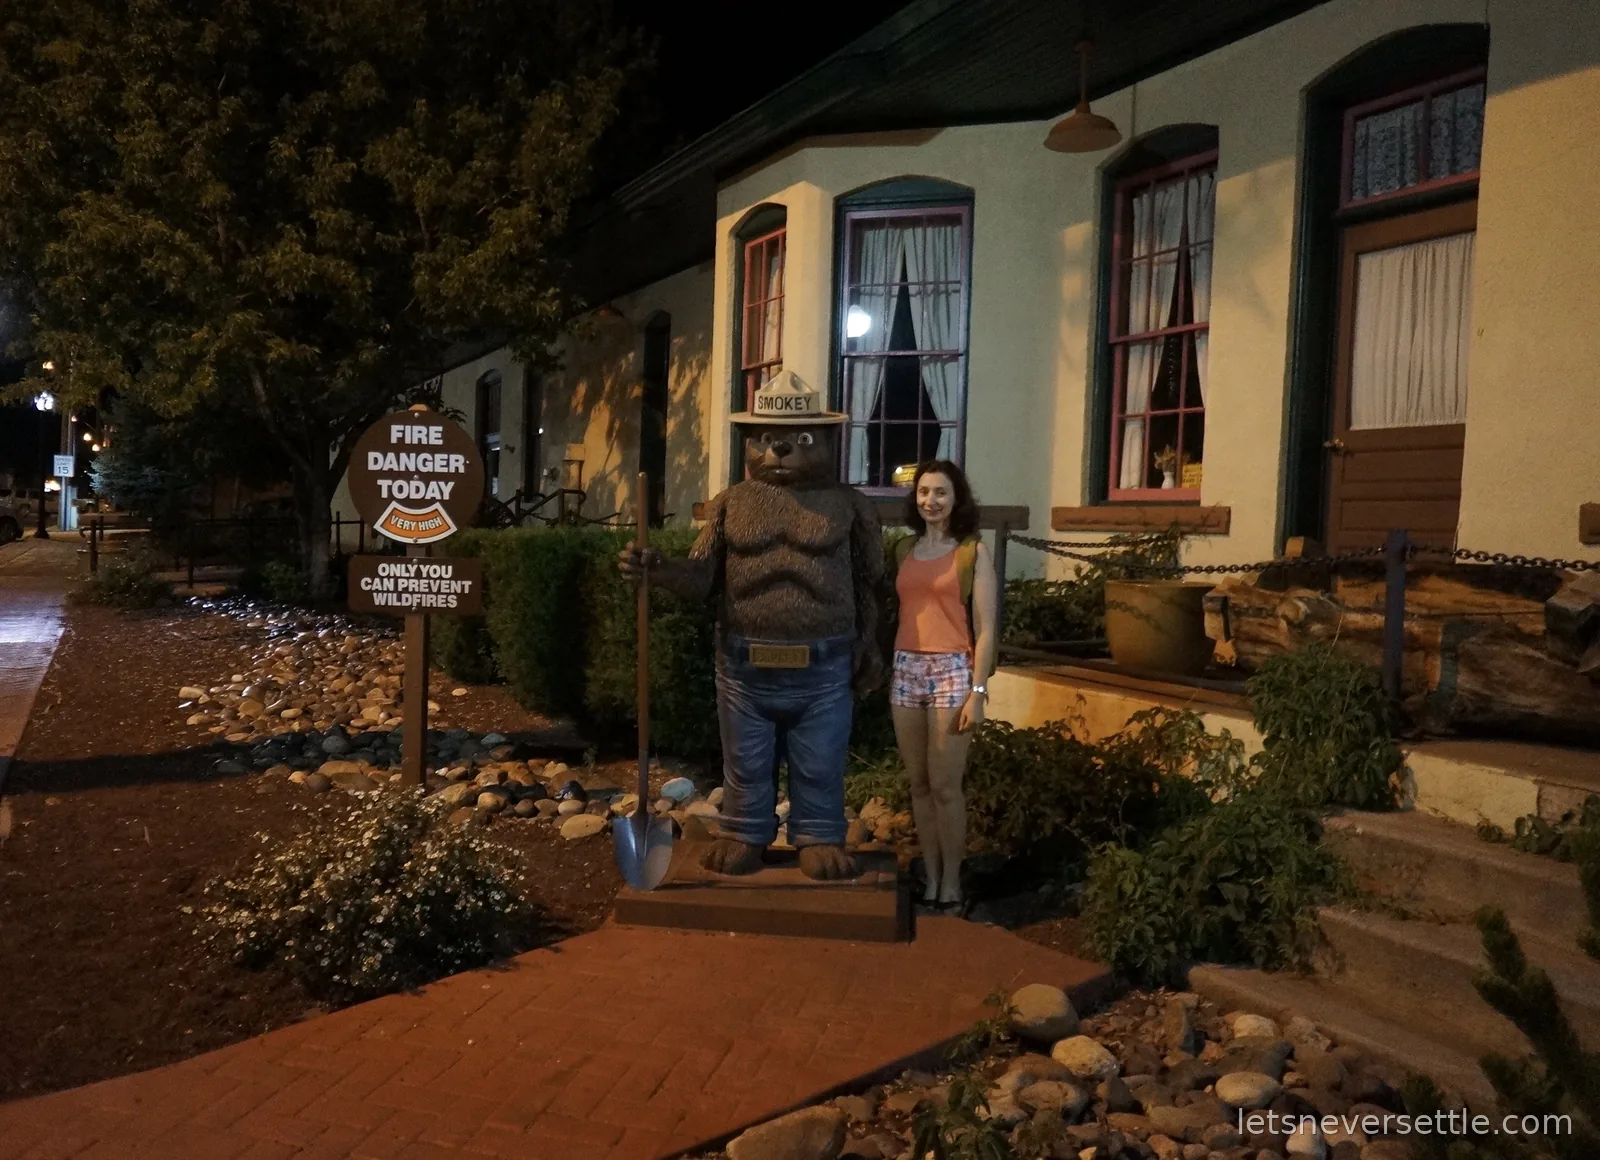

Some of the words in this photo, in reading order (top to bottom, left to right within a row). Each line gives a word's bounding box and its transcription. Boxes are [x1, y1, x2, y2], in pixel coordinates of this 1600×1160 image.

[757, 395, 812, 411] SMOKEY
[390, 424, 443, 445] FIRE
[58, 466, 69, 474] 15
[367, 451, 465, 473] DANGER
[377, 479, 455, 500] TODAY
[391, 515, 417, 531] VERY
[418, 517, 442, 531] HIGH
[377, 563, 417, 577] ONLY
[419, 565, 453, 578] YOU
[360, 577, 394, 592] CAN
[397, 579, 472, 593] PREVENT
[373, 592, 458, 608] WILDFIRES
